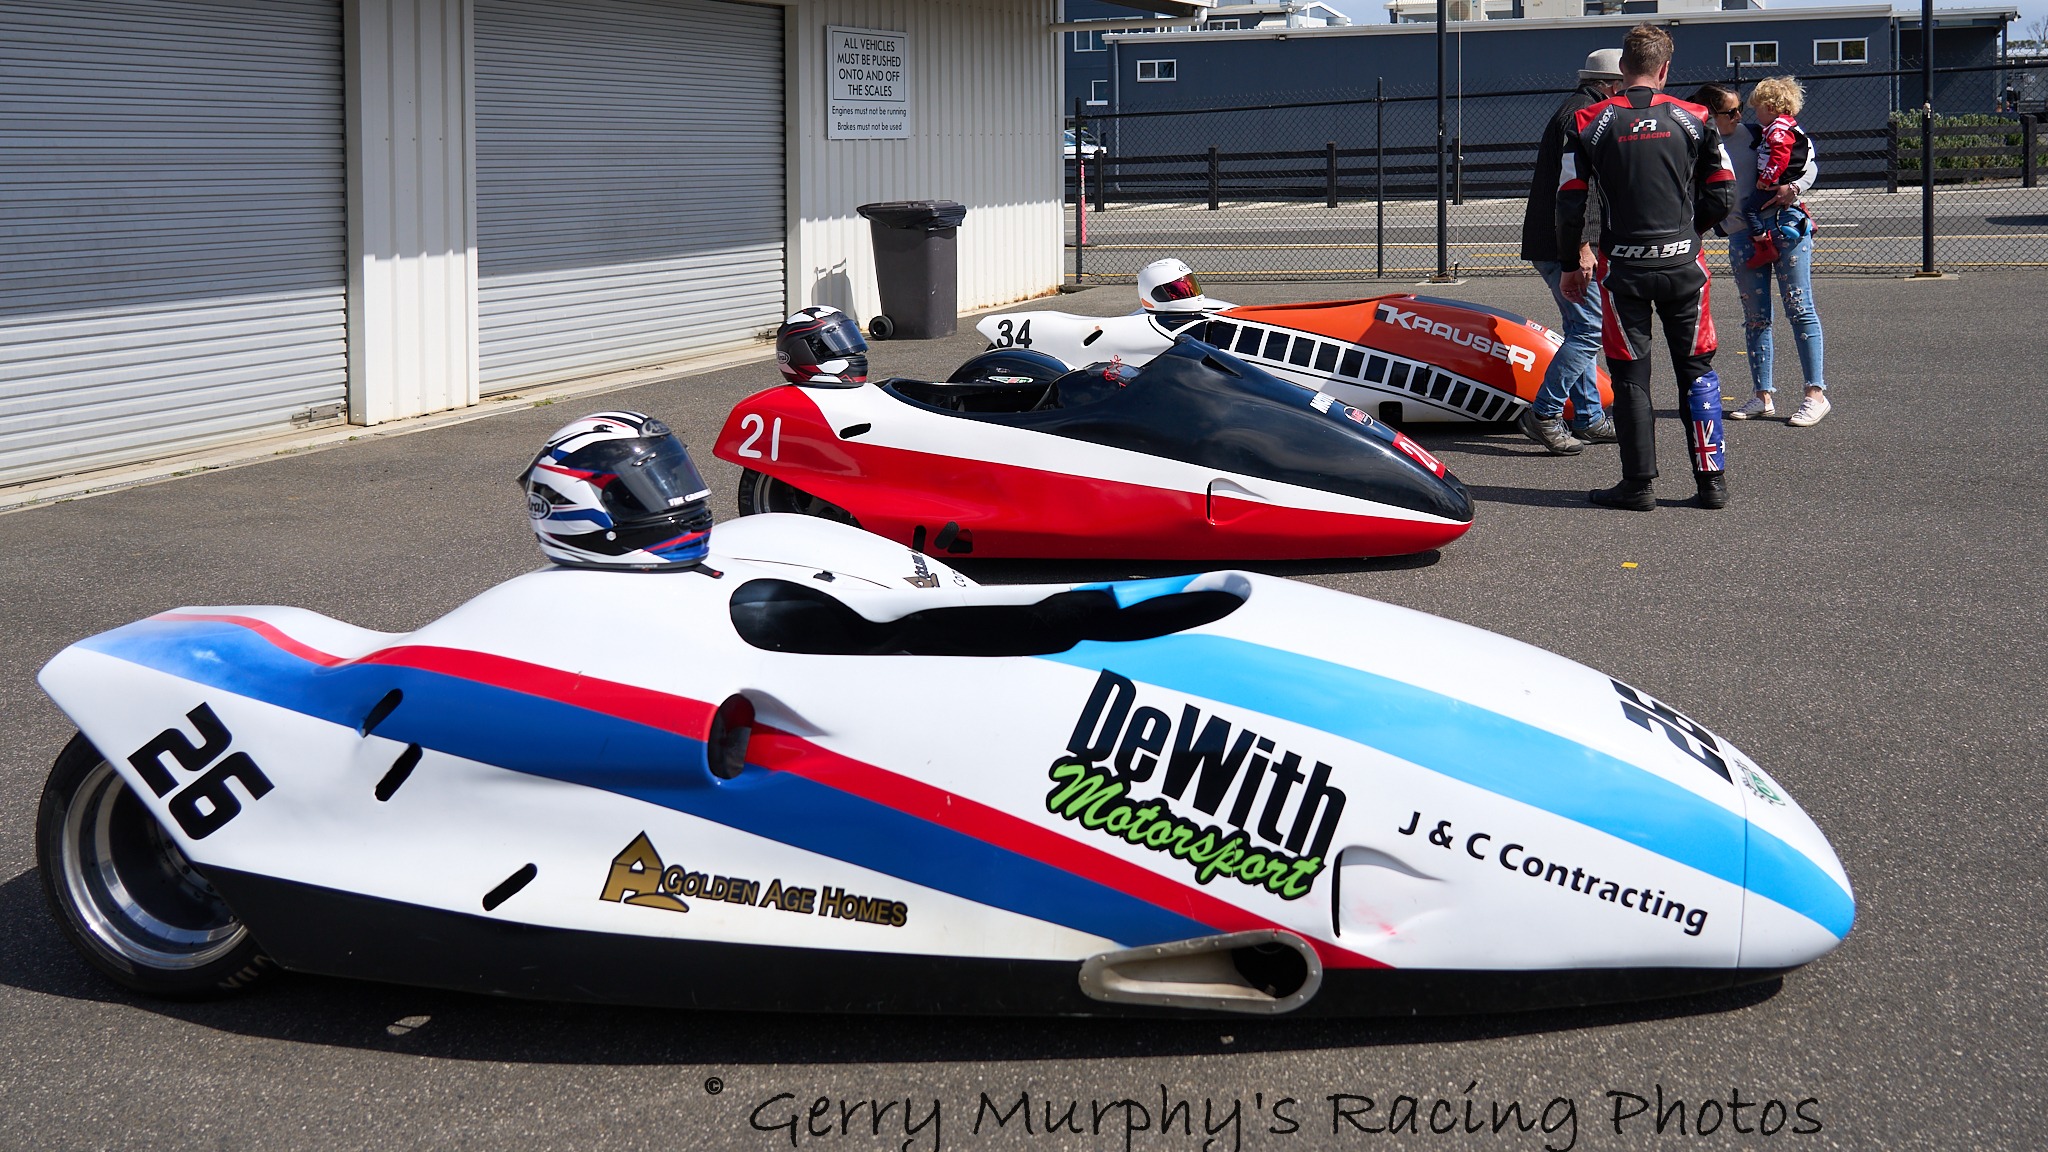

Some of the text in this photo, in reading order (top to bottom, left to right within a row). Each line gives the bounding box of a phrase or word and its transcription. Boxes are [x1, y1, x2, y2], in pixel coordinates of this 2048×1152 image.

[837, 53, 901, 67] MUST BE PUSHED
[844, 38, 895, 52] ALL VEHICLES
[839, 68, 900, 82] ONTO AND OFF
[848, 84, 892, 97] THE SCALES
[832, 106, 907, 117] Engines must not be running
[837, 122, 902, 131] Brakes must not be used
[1591, 108, 1615, 146] wintex
[1672, 108, 1700, 140] wintex
[1640, 131, 1671, 140] RACING
[996, 319, 1032, 348] 34
[1377, 303, 1536, 372] KRAUSER
[738, 413, 781, 461] 21
[1399, 436, 1440, 472] 21
[127, 701, 275, 840] 26
[1065, 667, 1347, 860] DeWith
[1048, 759, 1324, 899] Motorsport
[1398, 811, 1708, 936] J & C Contracting
[662, 864, 908, 928] GOLDEN AGE HOMES
